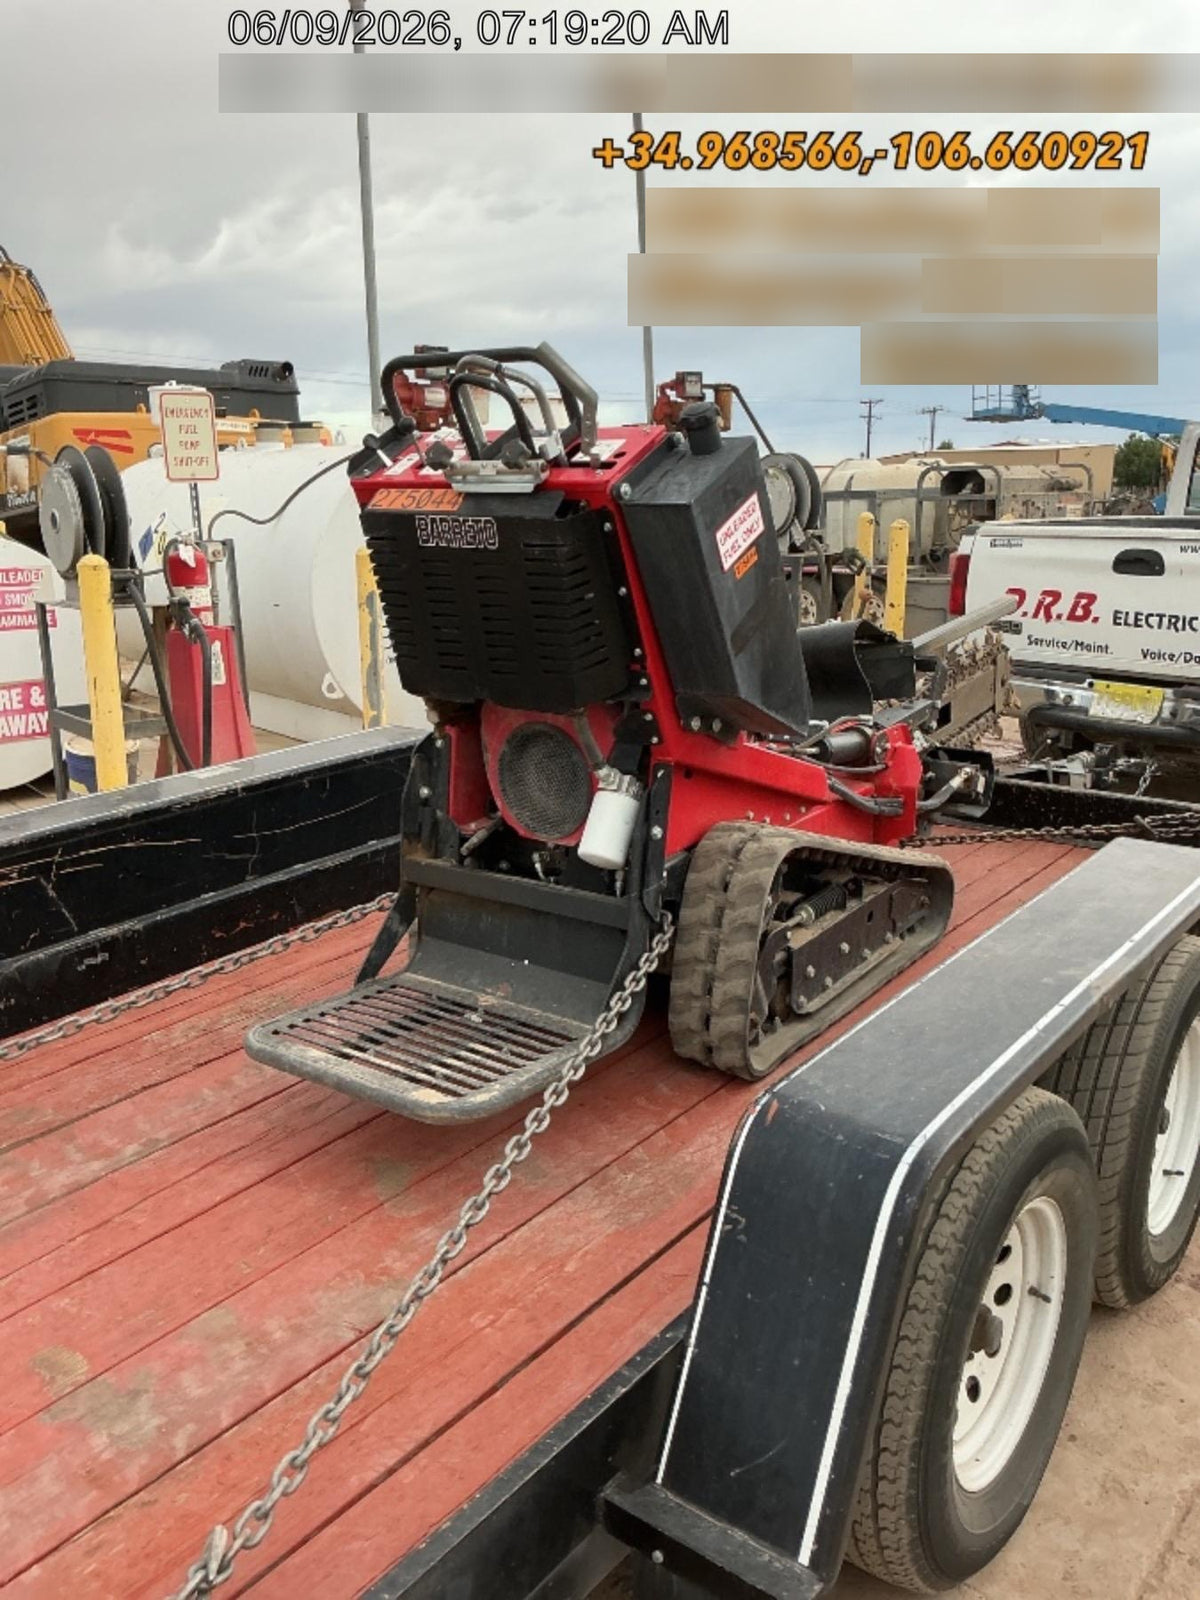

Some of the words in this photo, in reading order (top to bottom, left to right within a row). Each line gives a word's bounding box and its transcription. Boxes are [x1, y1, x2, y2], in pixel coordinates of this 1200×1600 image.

[415, 515, 499, 549] BARRETO
[0, 569, 43, 586] LEADED
[1112, 609, 1200, 633] ELECTRIC
[1027, 634, 1114, 655] Service/Maint.
[30, 685, 46, 708] &
[0, 711, 49, 739] AWAY
